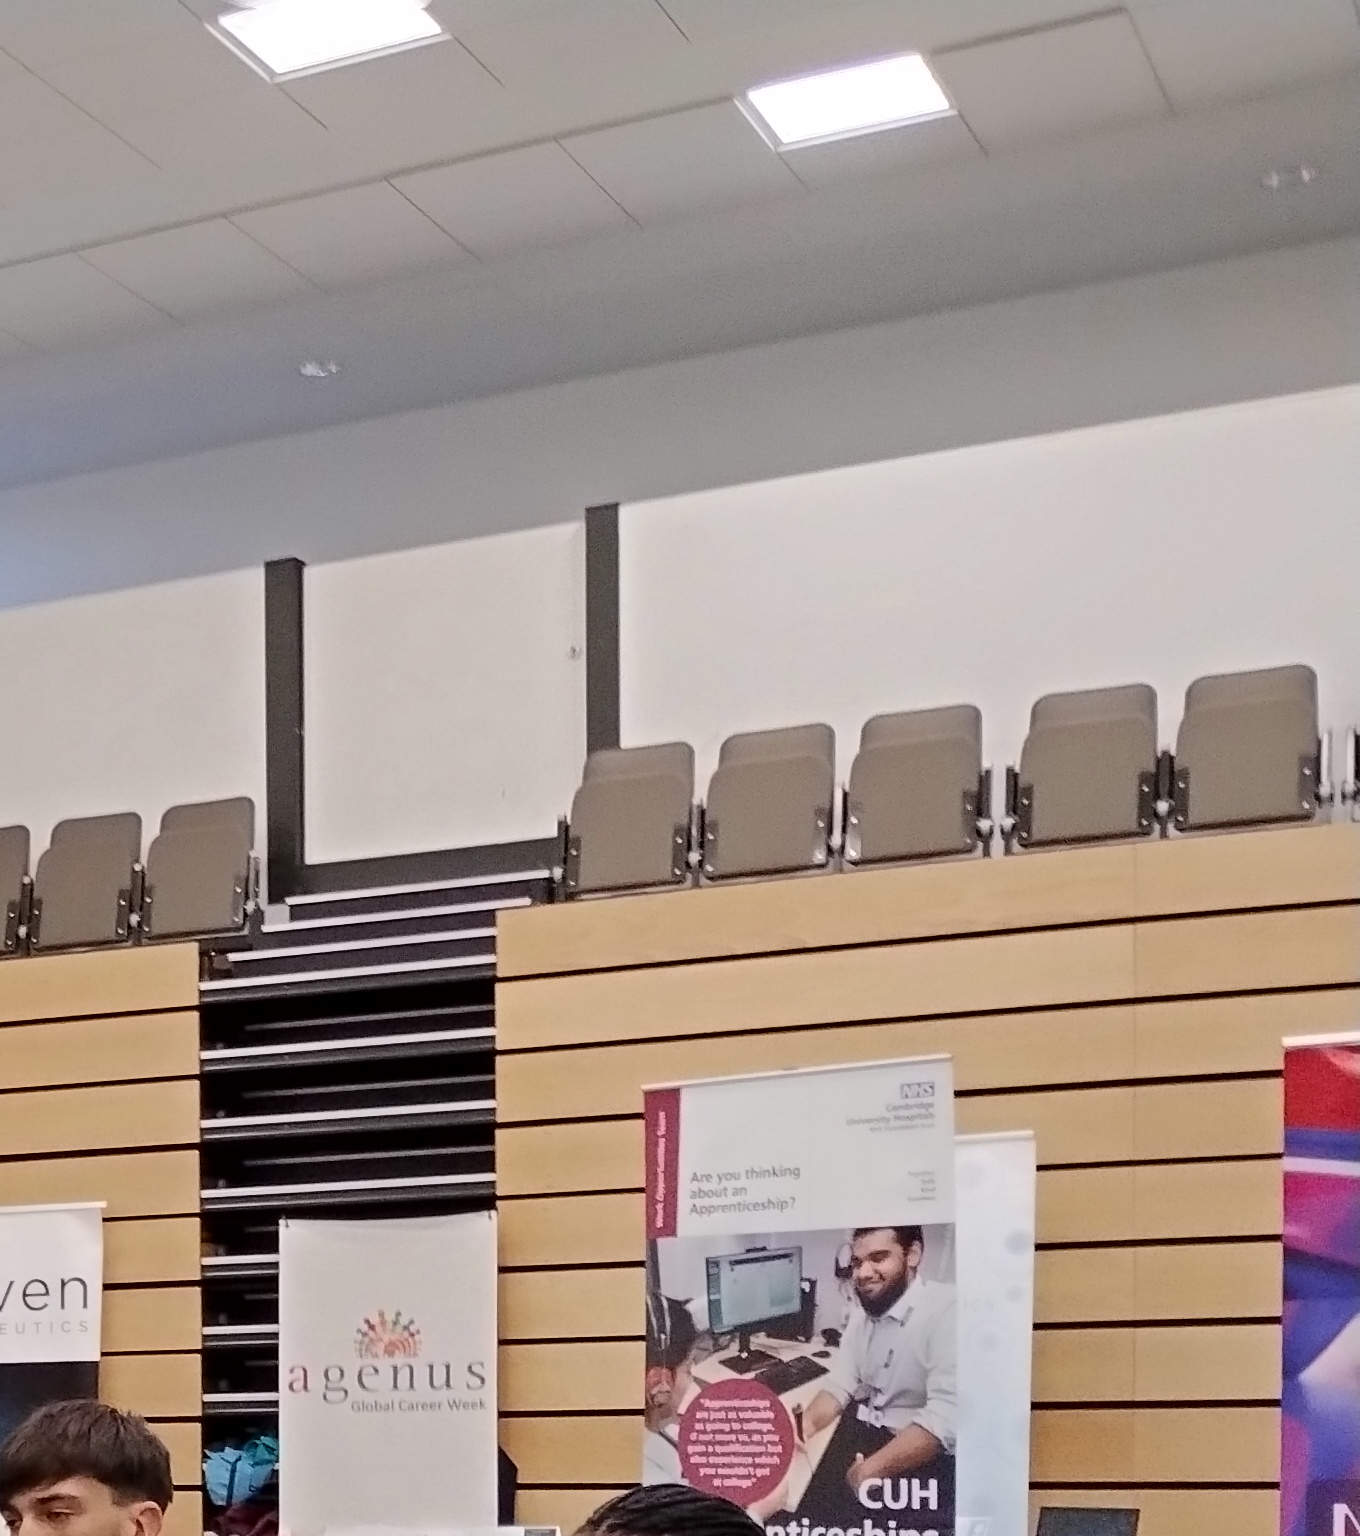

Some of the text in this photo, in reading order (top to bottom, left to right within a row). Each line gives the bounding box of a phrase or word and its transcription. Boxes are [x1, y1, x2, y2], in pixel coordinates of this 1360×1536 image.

[901, 1082, 935, 1099] NHS
[690, 1166, 801, 1185] Are you thinking
[690, 1186, 748, 1200] about an
[689, 1197, 796, 1217] Apprenticeship?
[288, 1360, 486, 1404] agenus
[351, 1399, 486, 1413] Global Career Week
[858, 1477, 938, 1510] CUH
